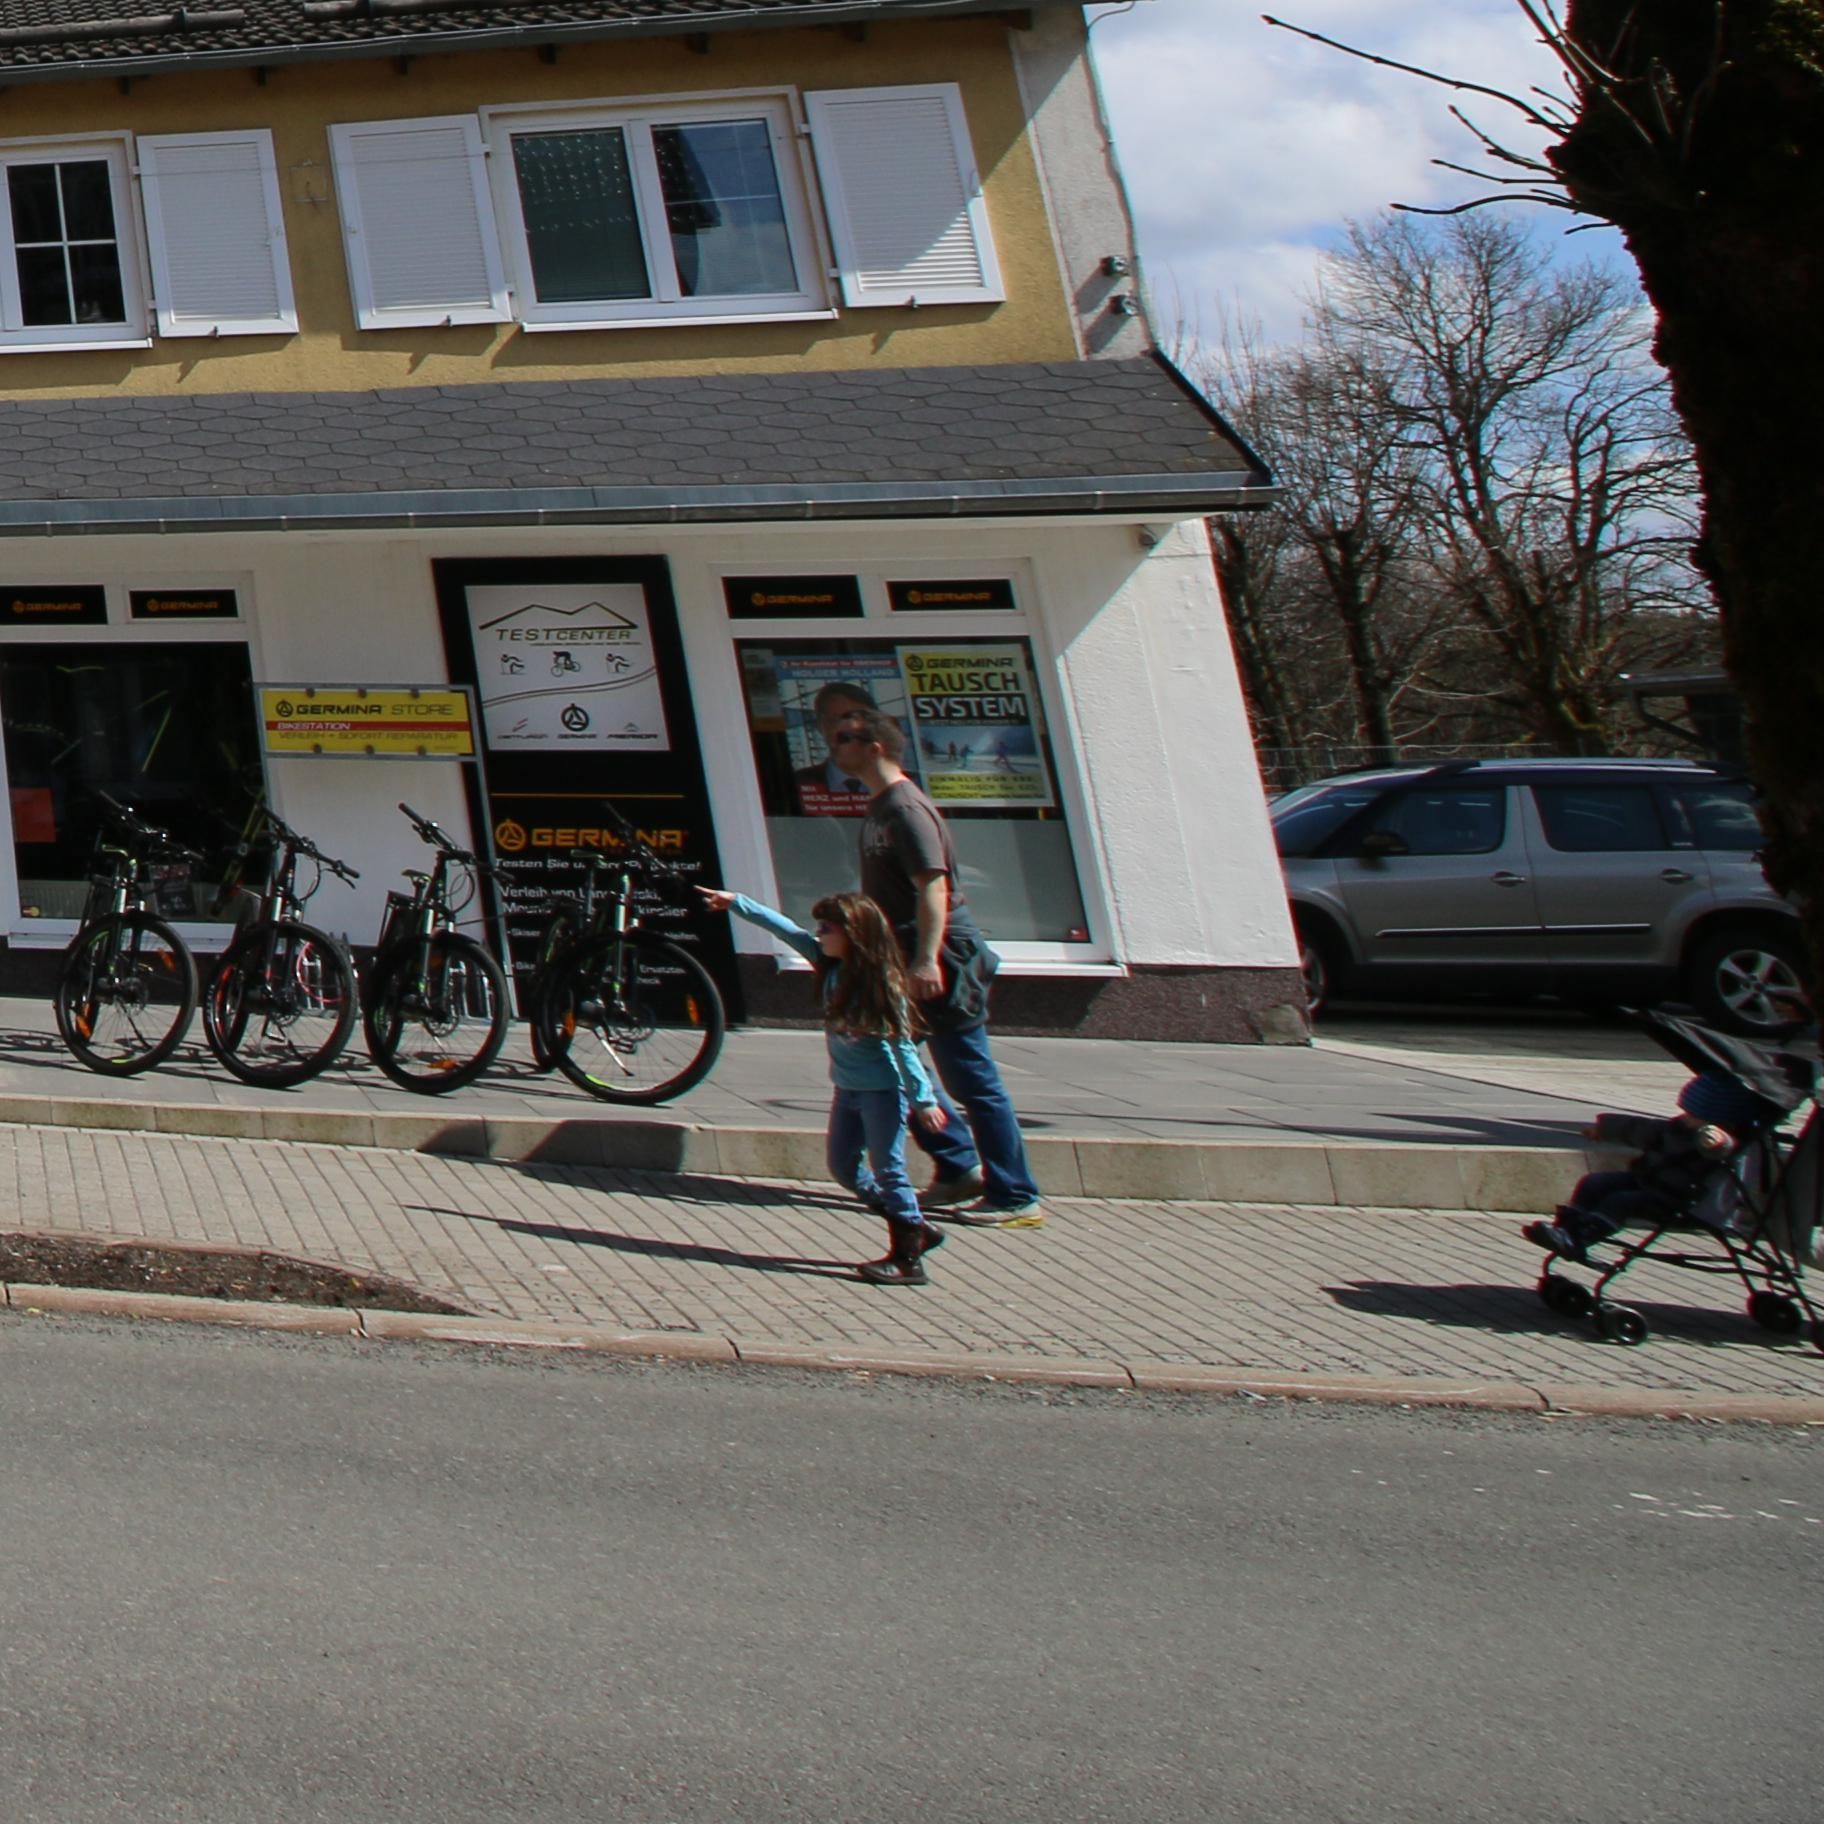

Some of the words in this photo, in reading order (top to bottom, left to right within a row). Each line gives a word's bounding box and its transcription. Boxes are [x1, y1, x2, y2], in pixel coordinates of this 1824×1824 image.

[495, 628, 632, 642] TESTCENTER
[926, 657, 1014, 669] GERMINA
[915, 672, 1021, 692] TAUSCH
[295, 703, 383, 715] GERMINA
[392, 704, 454, 715] STORE
[916, 697, 1025, 718] SYSTEM
[531, 828, 683, 847] GERMNA
[495, 858, 543, 869] Testen
[546, 858, 570, 869] Sie
